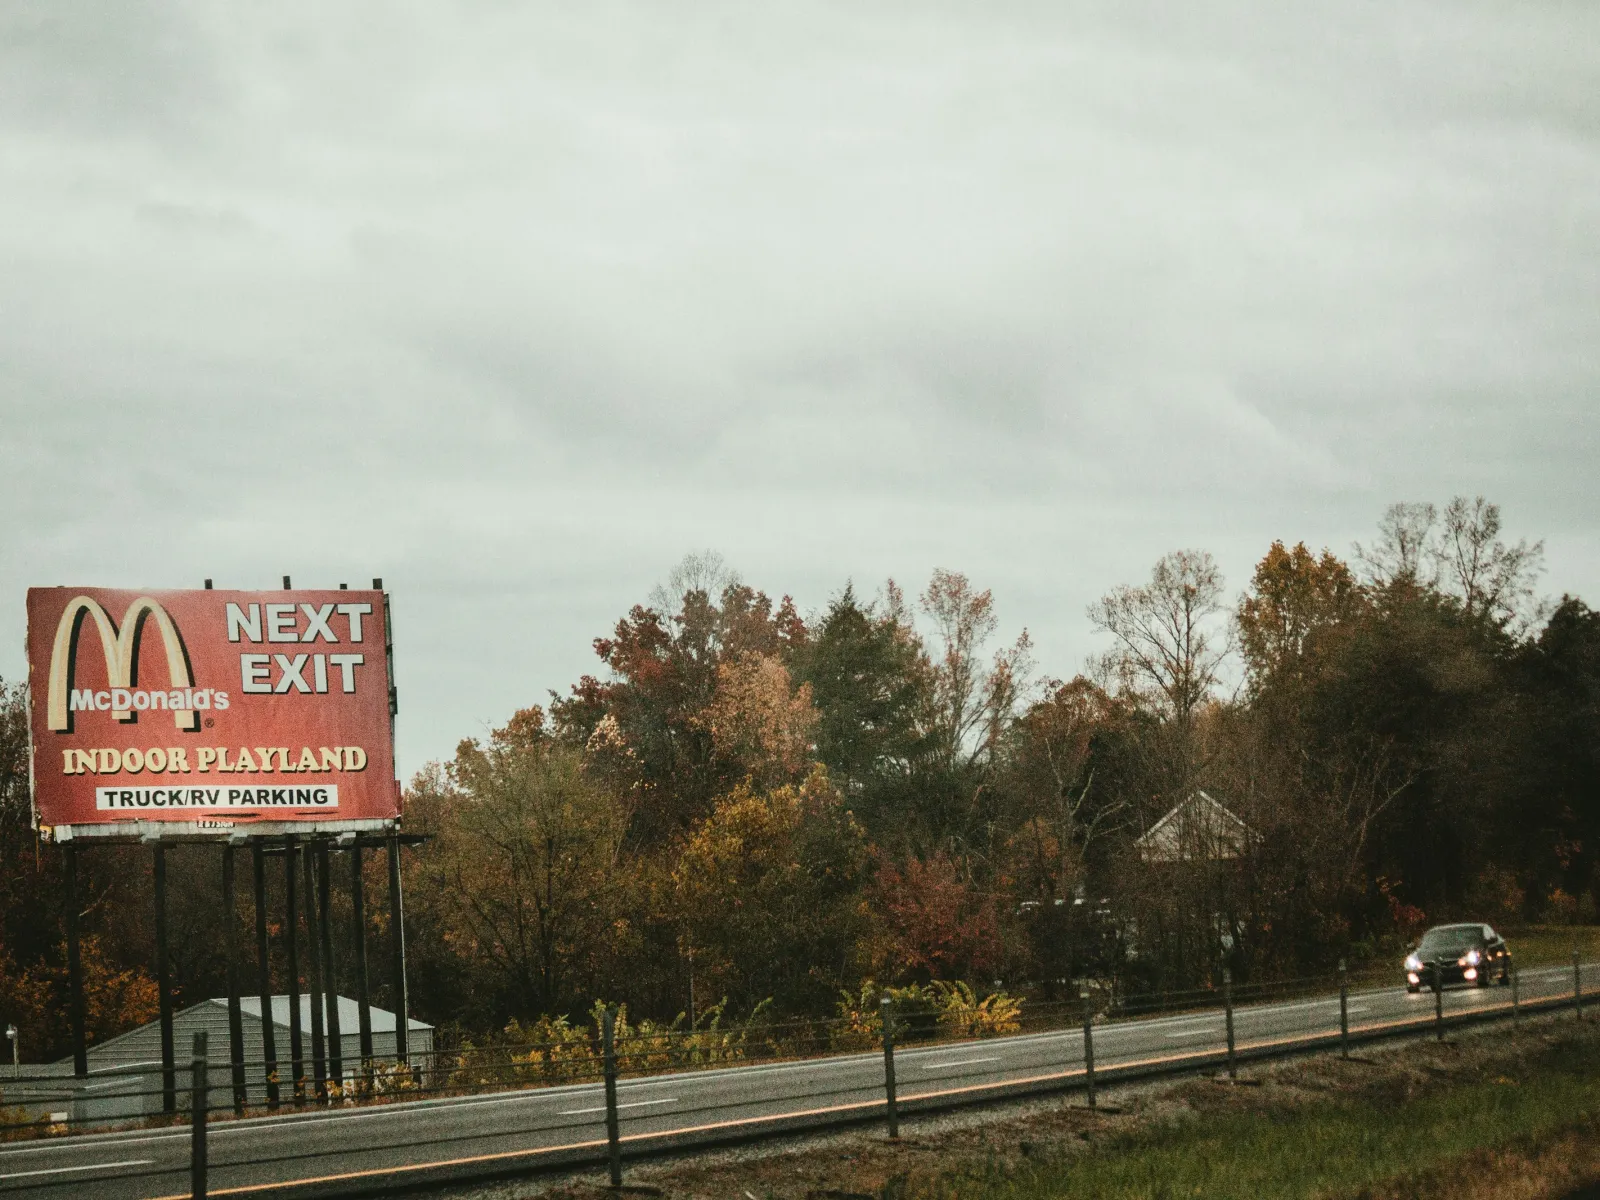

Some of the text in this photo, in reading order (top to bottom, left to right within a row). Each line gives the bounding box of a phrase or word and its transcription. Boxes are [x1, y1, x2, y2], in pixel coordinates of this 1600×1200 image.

[225, 602, 372, 643] NEXT
[240, 653, 364, 694] EXIT
[69, 688, 230, 711] McDonald's
[62, 746, 368, 775] INDOOR PLAYLAND
[104, 788, 329, 807] TRUCK/RV PARKING
